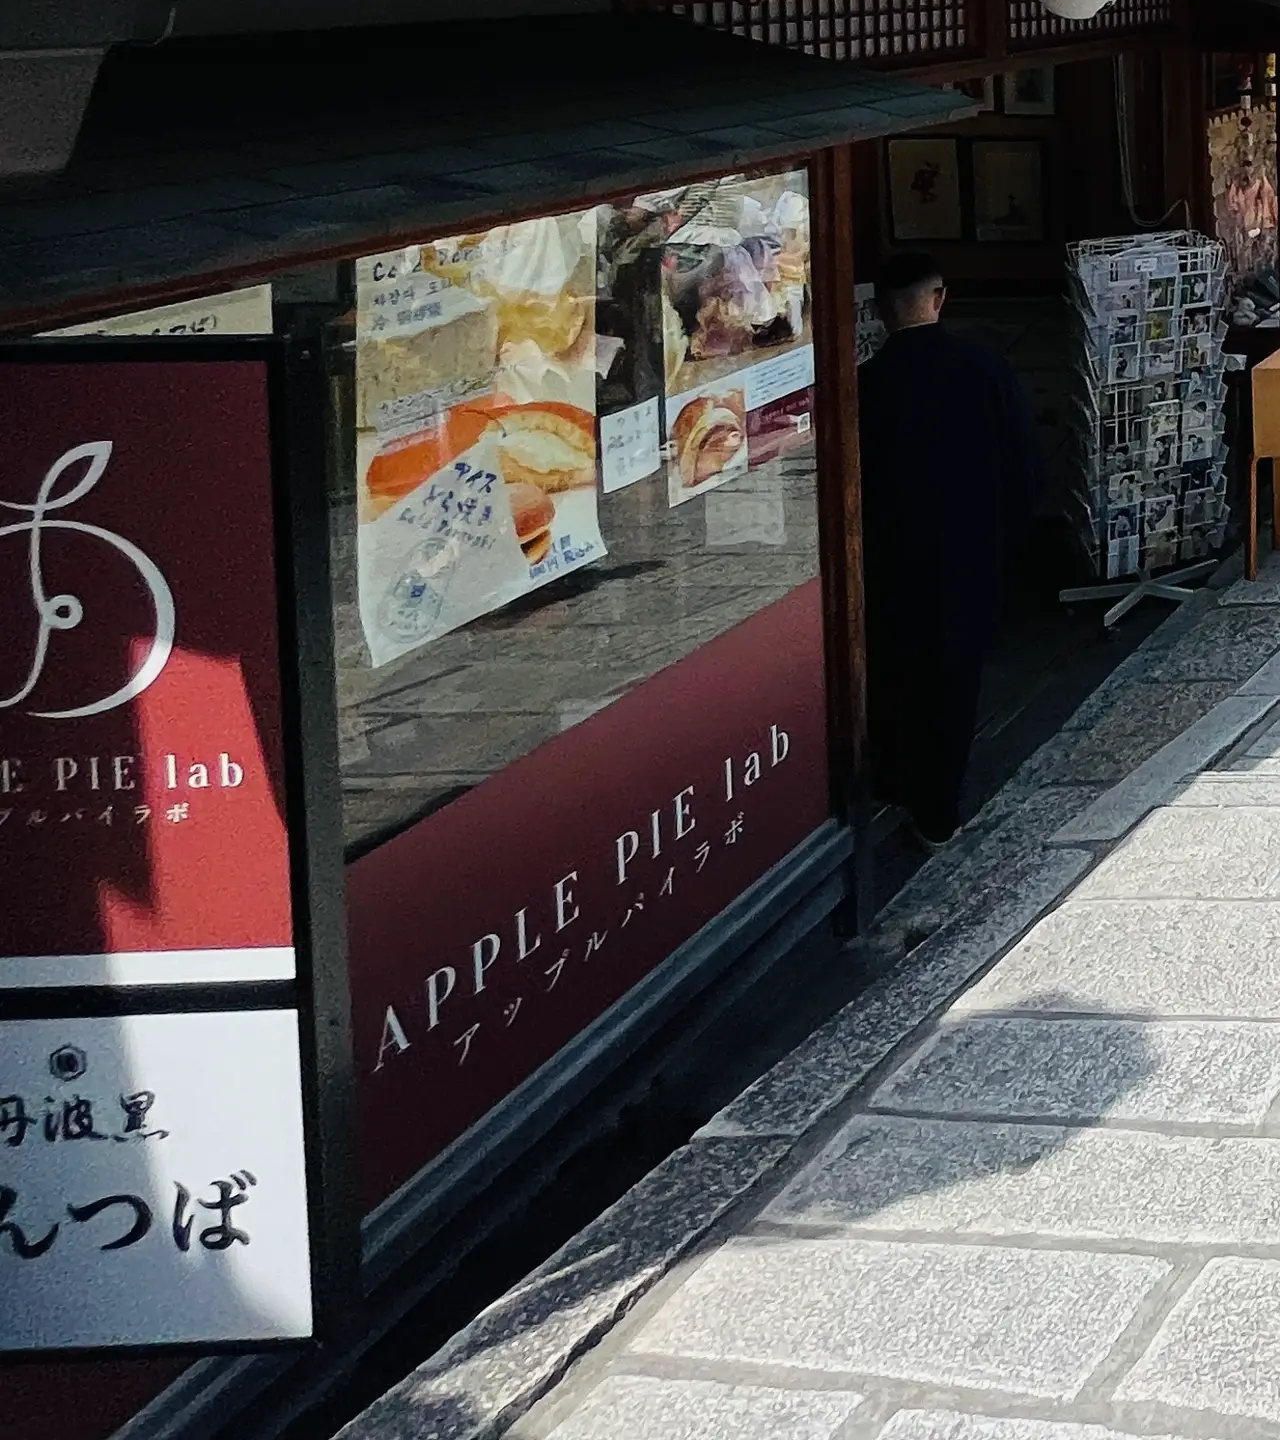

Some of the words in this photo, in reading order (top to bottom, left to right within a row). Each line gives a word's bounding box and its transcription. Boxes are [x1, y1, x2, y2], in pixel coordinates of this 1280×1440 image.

[56, 755, 137, 791] PIE
[165, 753, 245, 789] lab
[373, 870, 581, 1073] APPLE
[614, 785, 697, 885] PIE
[724, 724, 791, 800] lab
